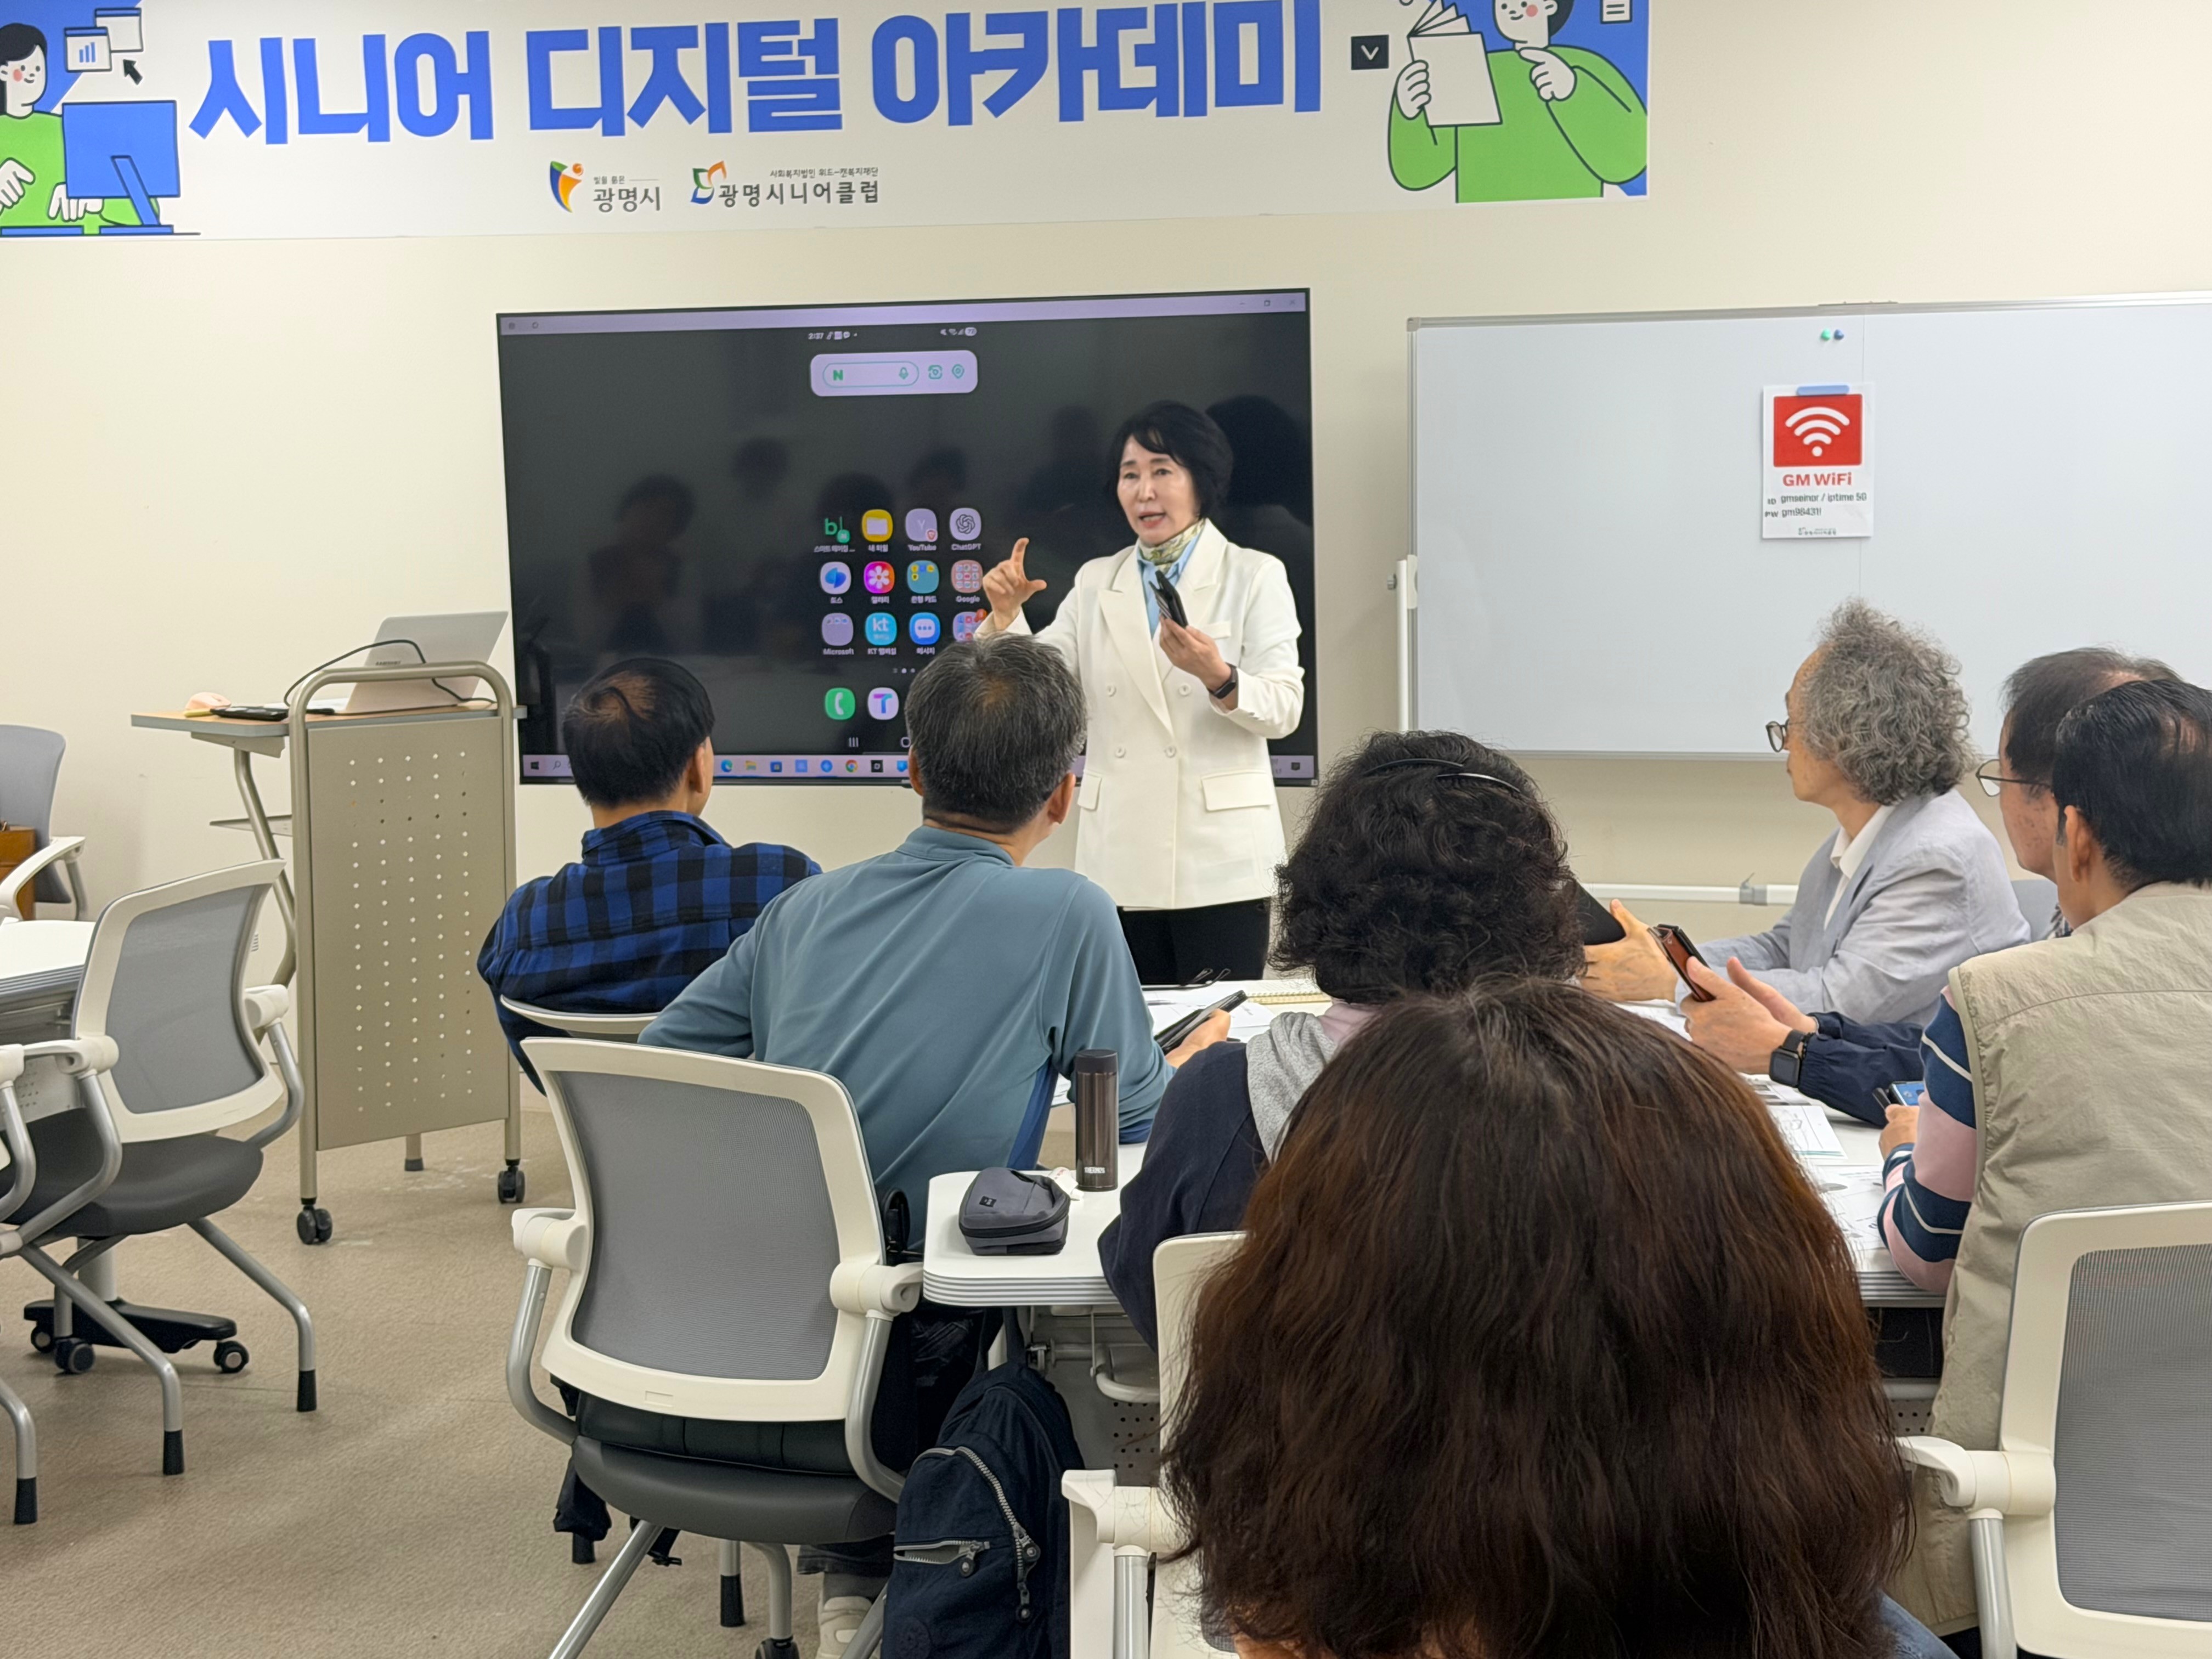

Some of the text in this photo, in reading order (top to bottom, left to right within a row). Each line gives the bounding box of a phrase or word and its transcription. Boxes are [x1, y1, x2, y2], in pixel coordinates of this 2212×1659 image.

[189, 0, 1322, 145] 시니어 디지털 아카데미
[592, 185, 661, 213] 광명시
[718, 180, 879, 208] 광명시니어클럽
[1782, 472, 1852, 487] GM WiFi
[956, 595, 980, 604] Google
[872, 617, 889, 631] kt
